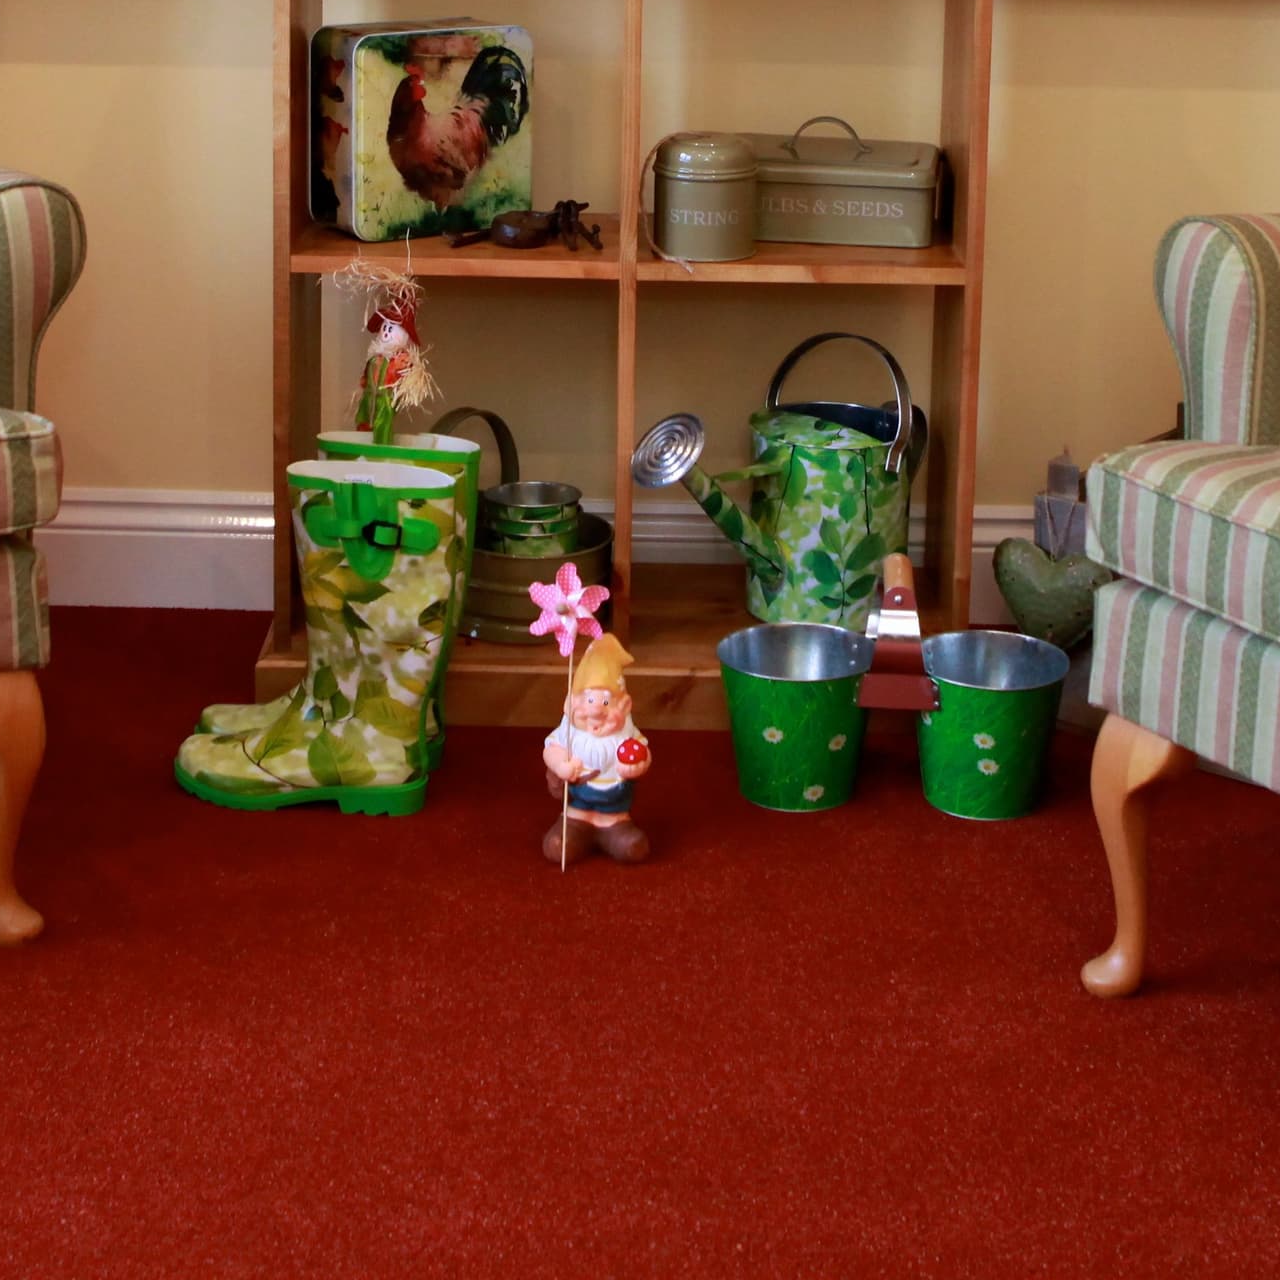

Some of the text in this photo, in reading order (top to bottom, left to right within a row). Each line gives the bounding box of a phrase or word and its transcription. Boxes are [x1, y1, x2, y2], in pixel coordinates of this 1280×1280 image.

[669, 207, 739, 226] STRING
[812, 199, 827, 215] &
[832, 199, 905, 218] SEEDS
